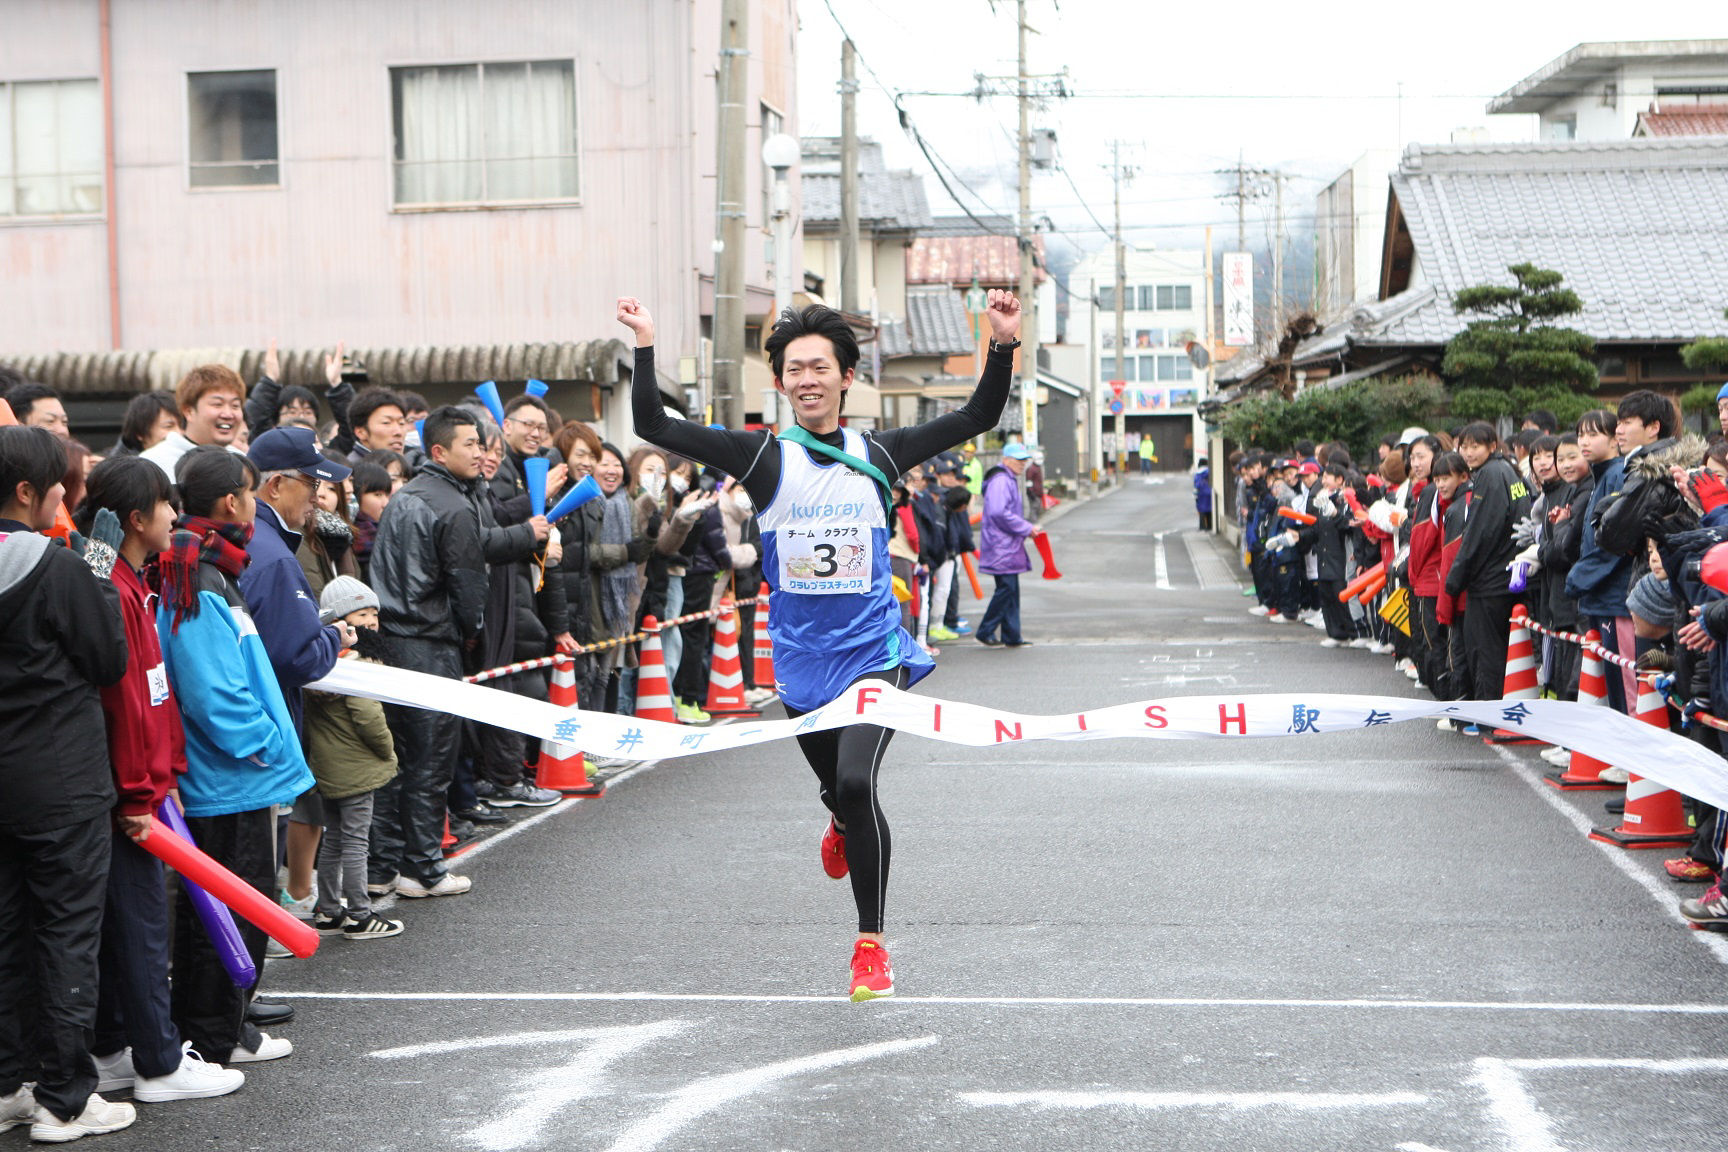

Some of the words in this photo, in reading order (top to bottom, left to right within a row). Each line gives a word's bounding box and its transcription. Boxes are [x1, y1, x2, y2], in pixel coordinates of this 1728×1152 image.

[791, 502, 865, 519] kuraray
[788, 529, 815, 538] チーム
[813, 543, 838, 577] 3
[789, 580, 864, 590] クラレプラスチックス
[856, 687, 1247, 743] FINISH
[1287, 702, 1532, 734] 駅伝会
